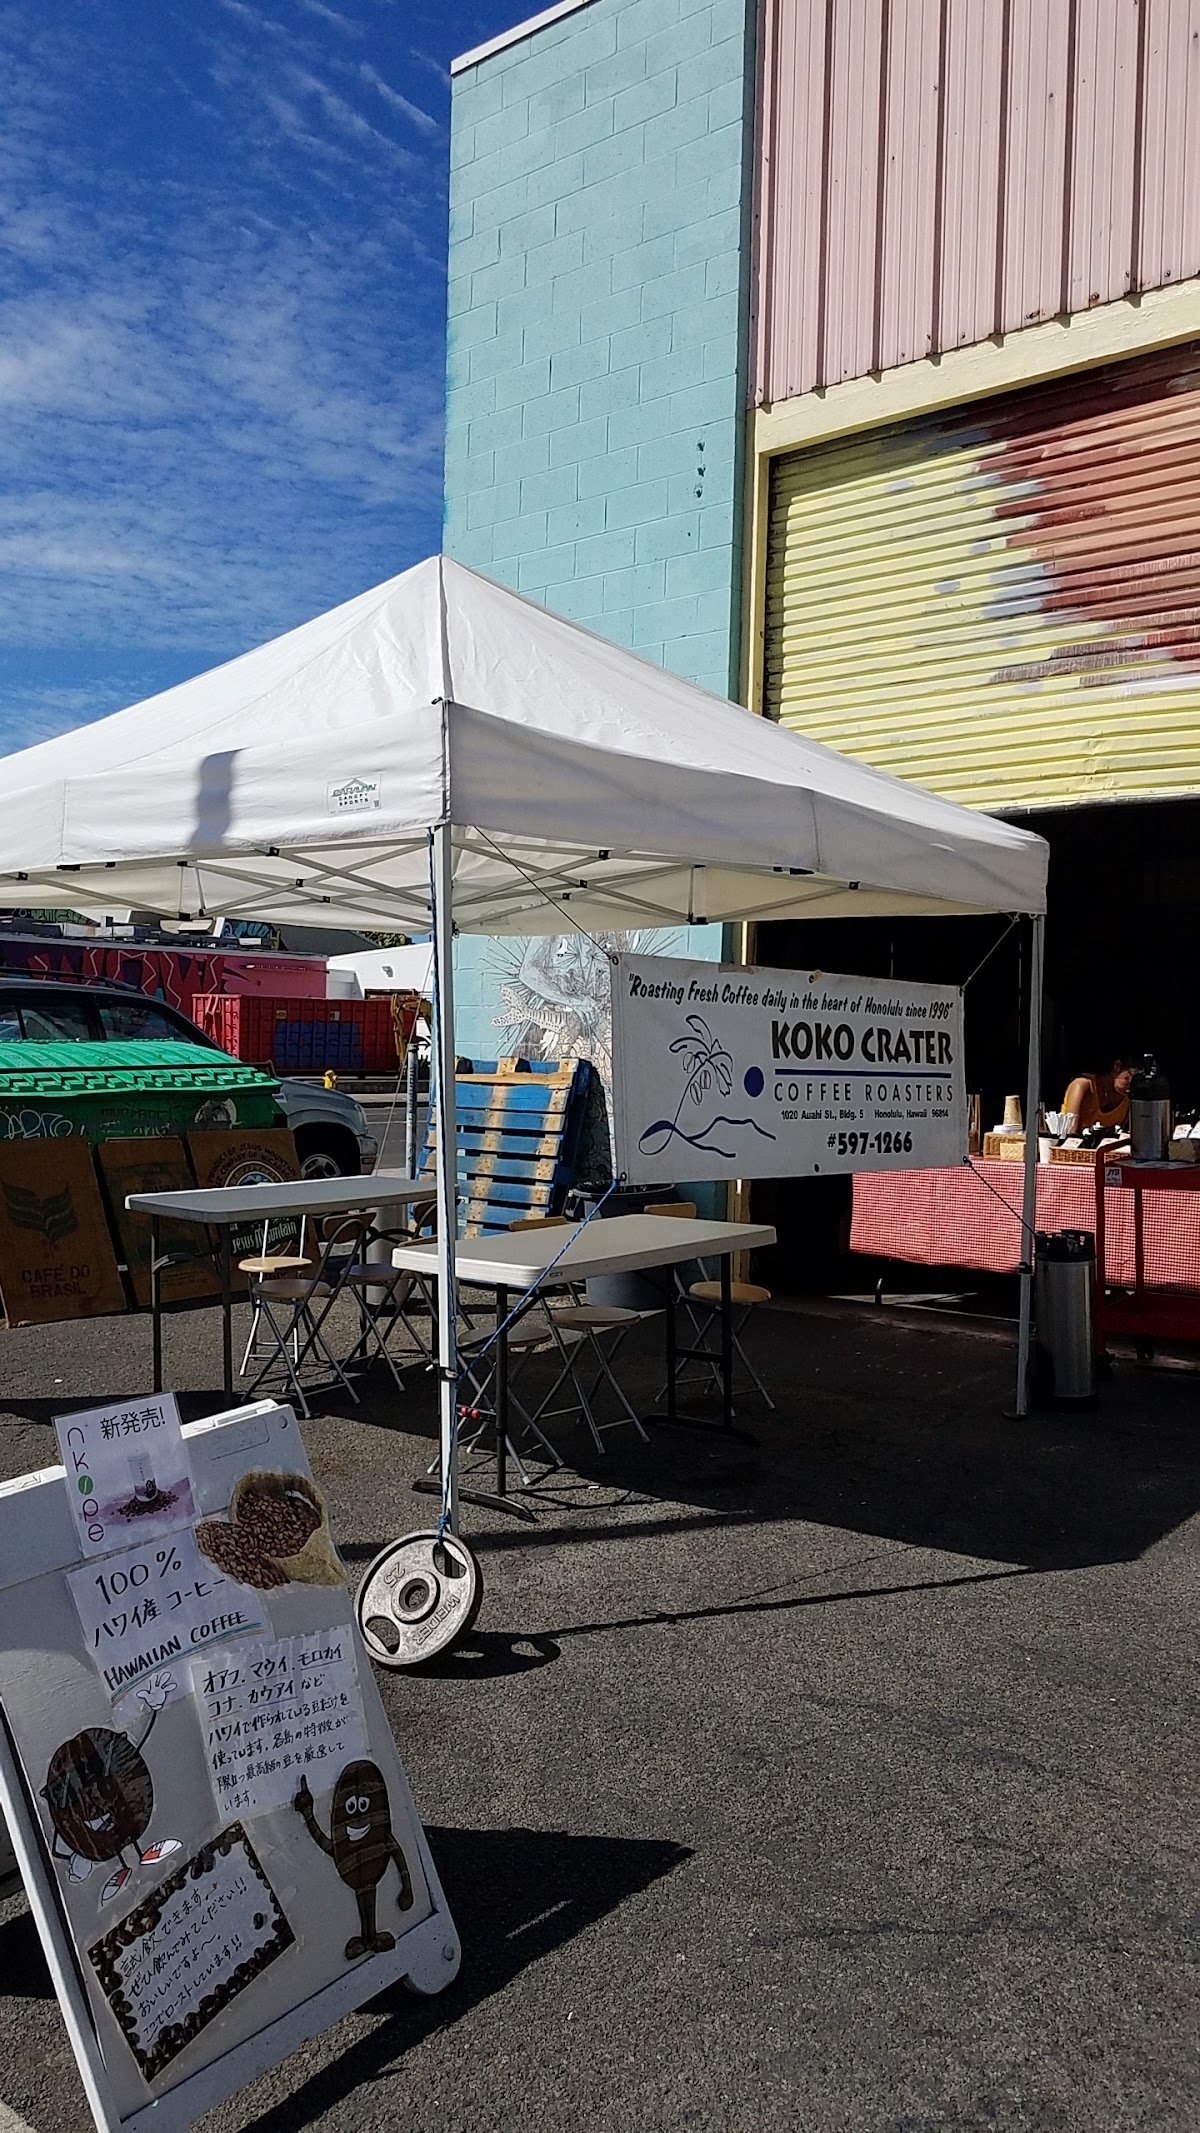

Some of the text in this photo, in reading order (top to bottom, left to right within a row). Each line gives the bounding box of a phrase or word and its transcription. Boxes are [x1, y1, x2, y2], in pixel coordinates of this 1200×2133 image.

[628, 973, 685, 1006] "Roasting
[687, 980, 719, 1003] Fresh
[721, 983, 759, 1006] Coffee
[761, 988, 788, 1013] daily
[789, 992, 799, 1009] in
[802, 992, 818, 1010] the
[820, 993, 848, 1012] heart
[850, 995, 863, 1013] of
[864, 997, 903, 1017] Honolulu
[904, 1002, 927, 1018] since
[771, 1020, 954, 1065] KOKO CRATER
[773, 1082, 953, 1102] COFFEE ROASTERS
[780, 1109, 798, 1120] 1020
[801, 1109, 822, 1120] Auahi
[839, 1109, 857, 1121] Bldg.
[859, 1109, 864, 1119] 5
[874, 1108, 905, 1120] Honolulu,
[906, 1108, 927, 1119] Hawaii
[827, 1131, 913, 1155] #597-1266
[232, 1234, 255, 1254] Jesus
[70, 1264, 90, 1279] DO
[30, 1281, 88, 1298] BRASIL
[100, 1406, 166, 1441] 新発売!
[383, 1562, 406, 1588] 25
[93, 1578, 227, 1648] ハワイ産 コーヒー
[412, 1594, 461, 1646] WEIDER
[102, 1610, 248, 1692] HAWAIIAN COFFEE
